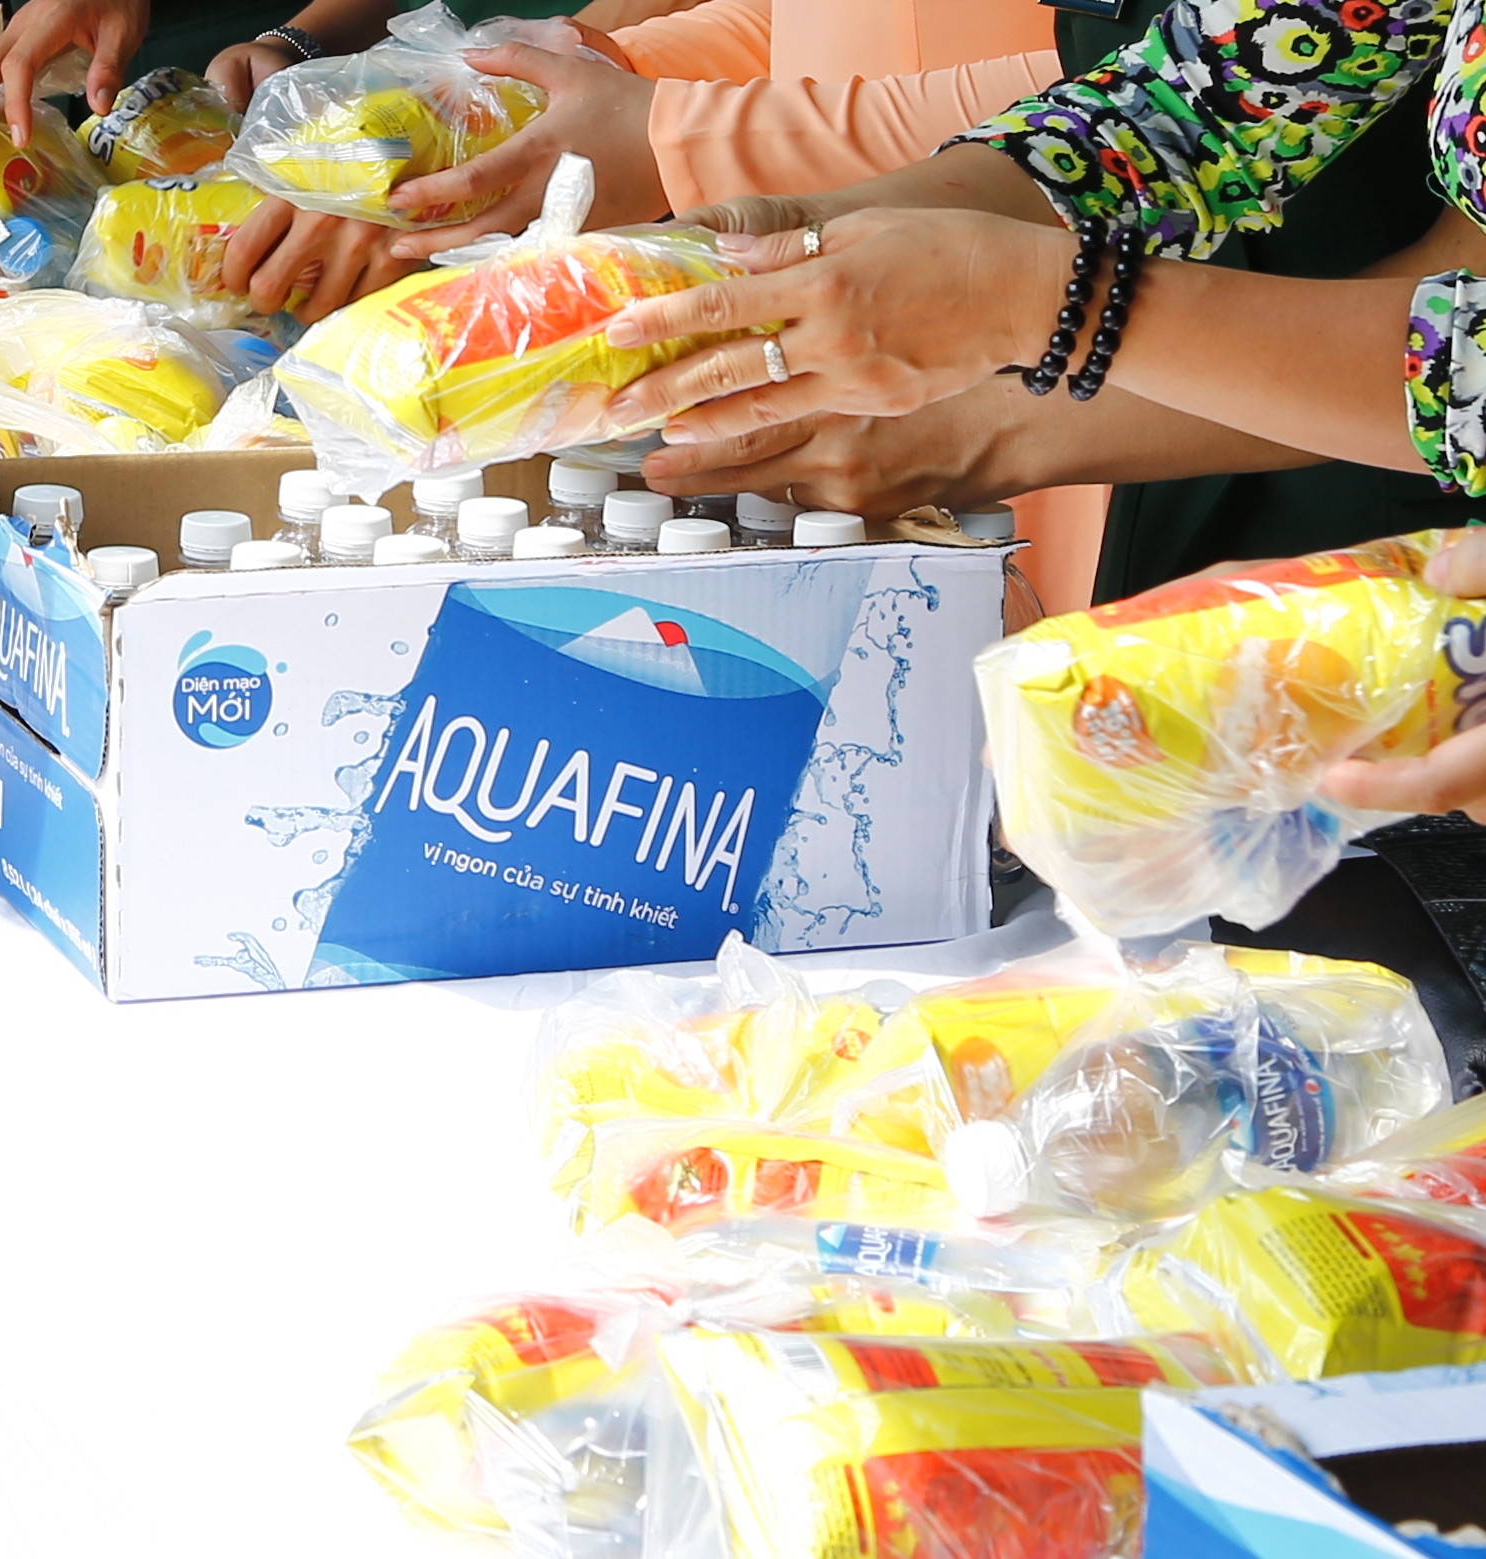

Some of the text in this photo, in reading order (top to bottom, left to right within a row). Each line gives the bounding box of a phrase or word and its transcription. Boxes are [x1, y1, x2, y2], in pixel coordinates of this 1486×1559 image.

[181, 676, 261, 696] Diện mạo
[187, 691, 251, 724] Mới
[373, 694, 756, 913] AQUAFINA
[422, 841, 679, 930] vị ngon của sự tinh khiết
[1257, 1053, 1298, 1170] AQUAFINA
